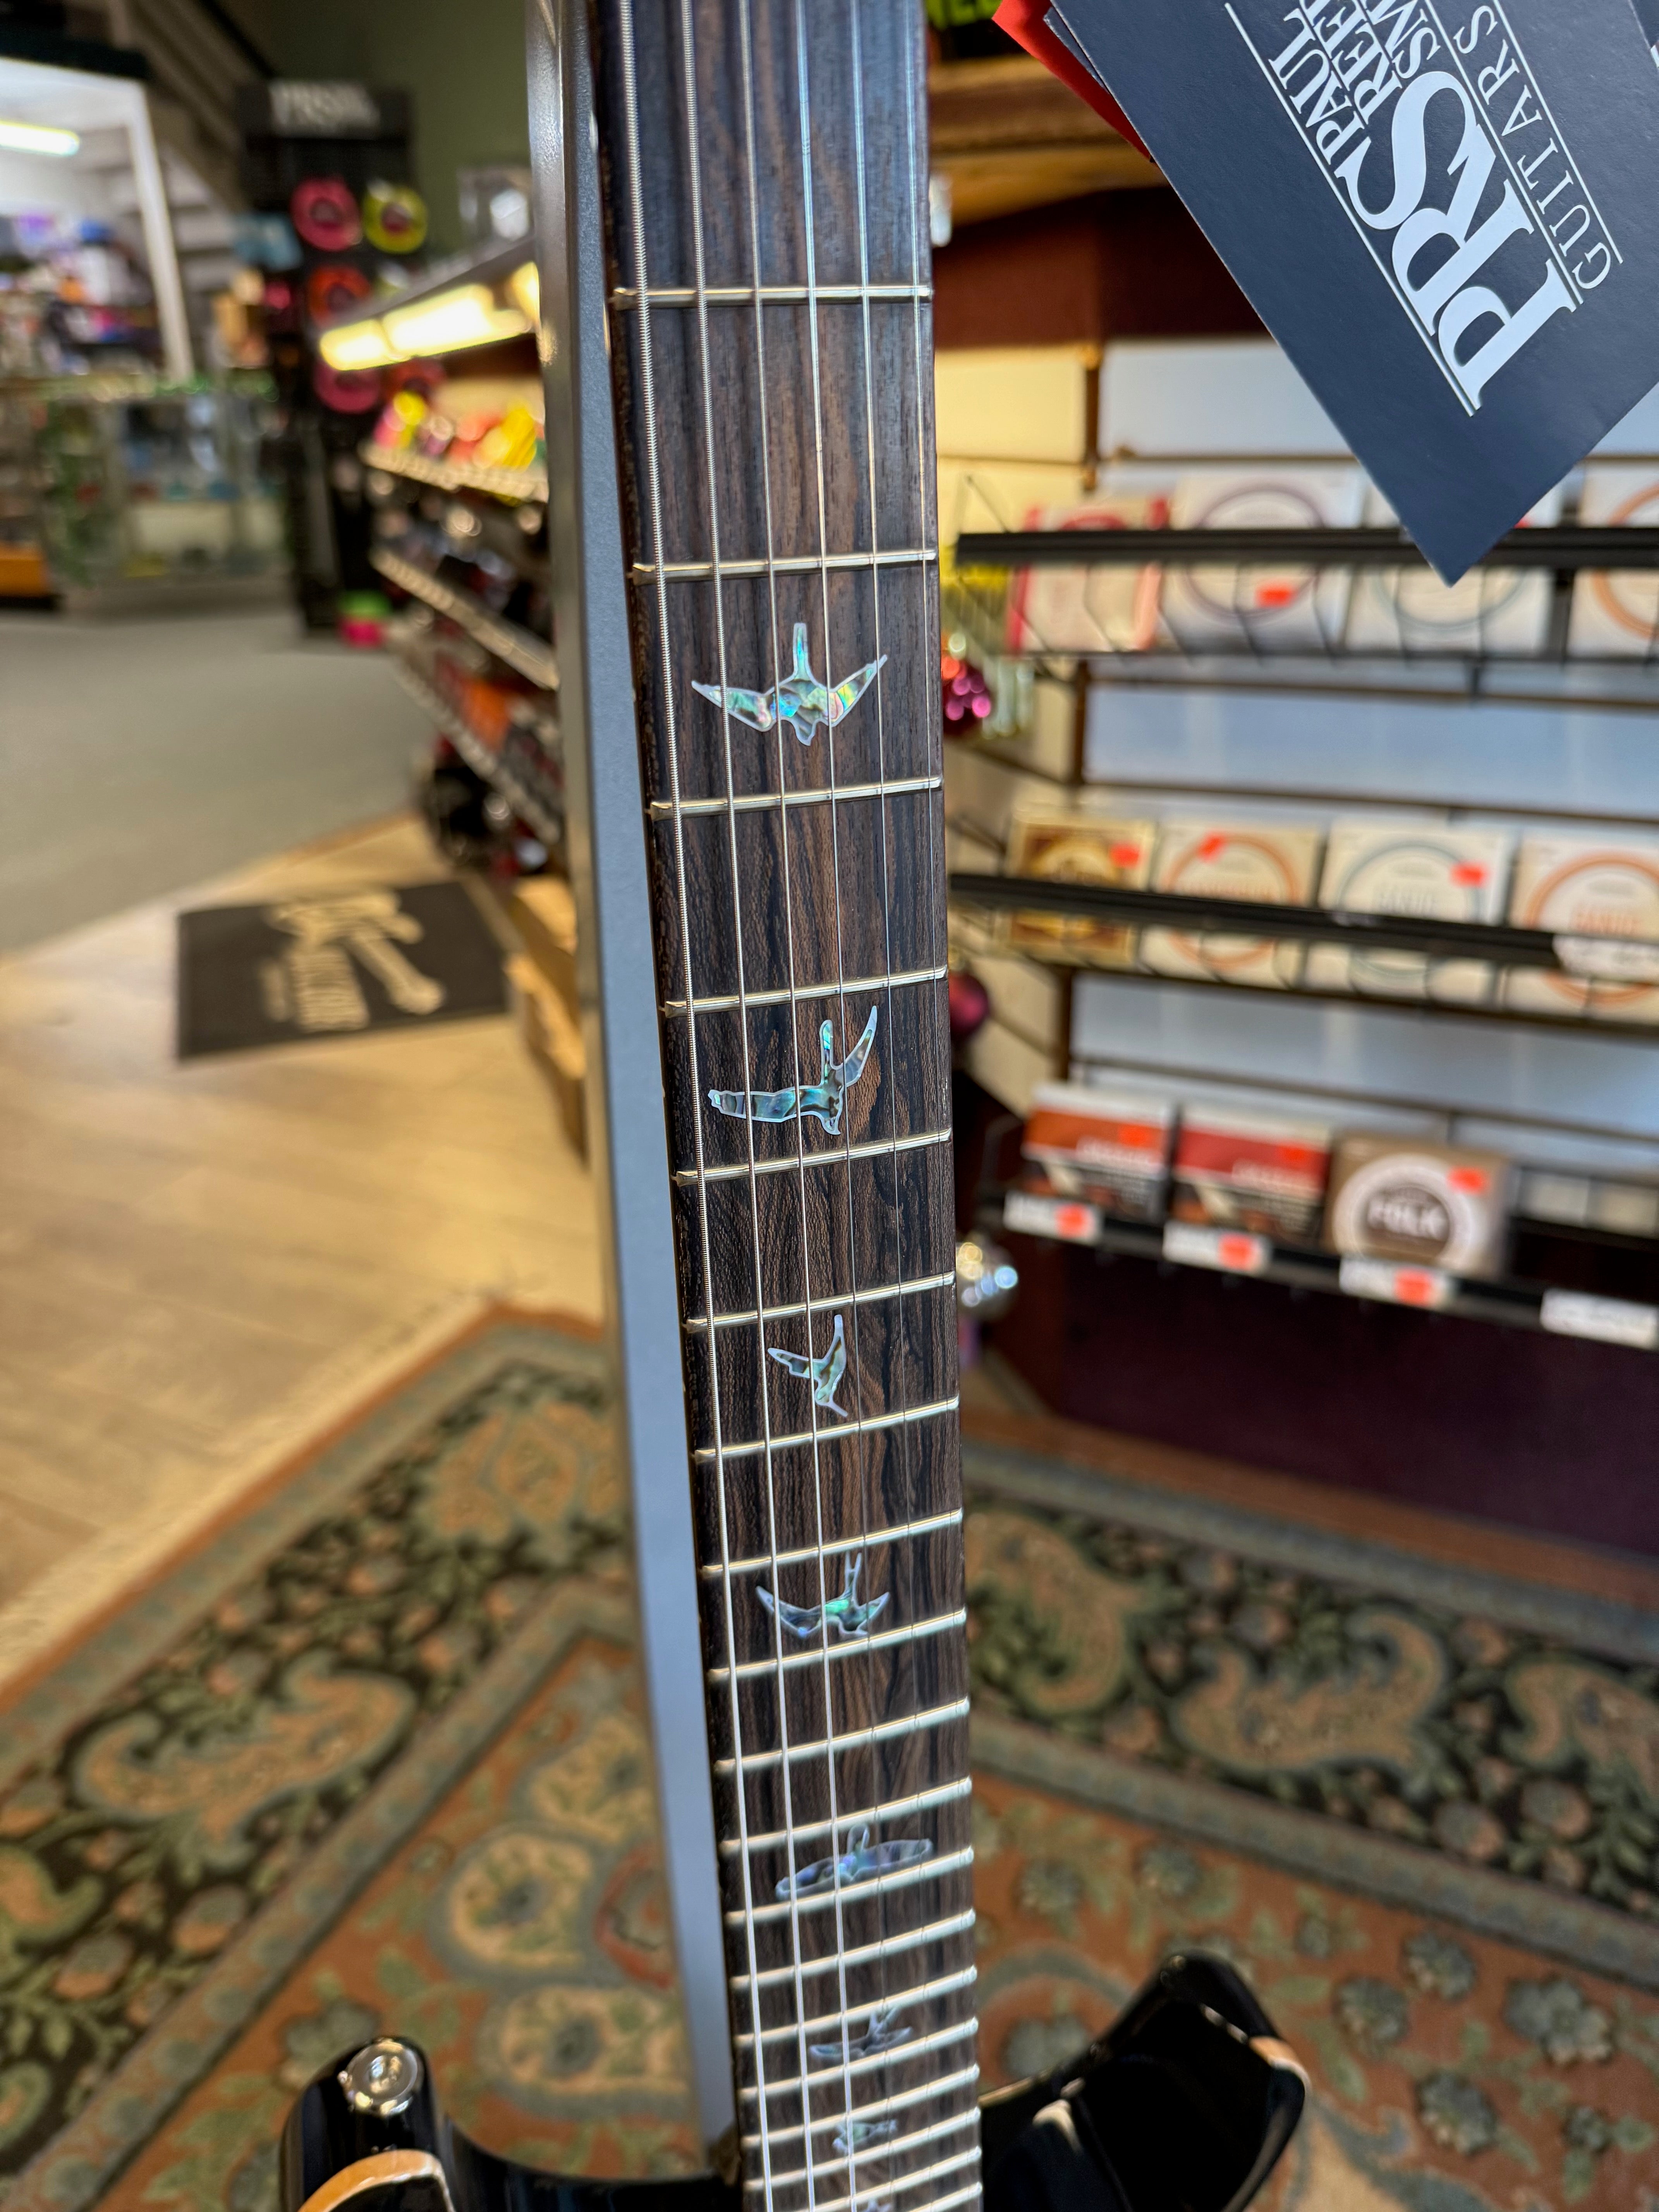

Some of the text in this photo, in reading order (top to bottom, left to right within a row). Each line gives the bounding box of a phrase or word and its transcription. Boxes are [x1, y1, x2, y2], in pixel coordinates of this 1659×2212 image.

[1268, 8, 1365, 165] PAUL
[1453, 5, 1612, 290] GUITARS
[1333, 71, 1577, 410] PRS
